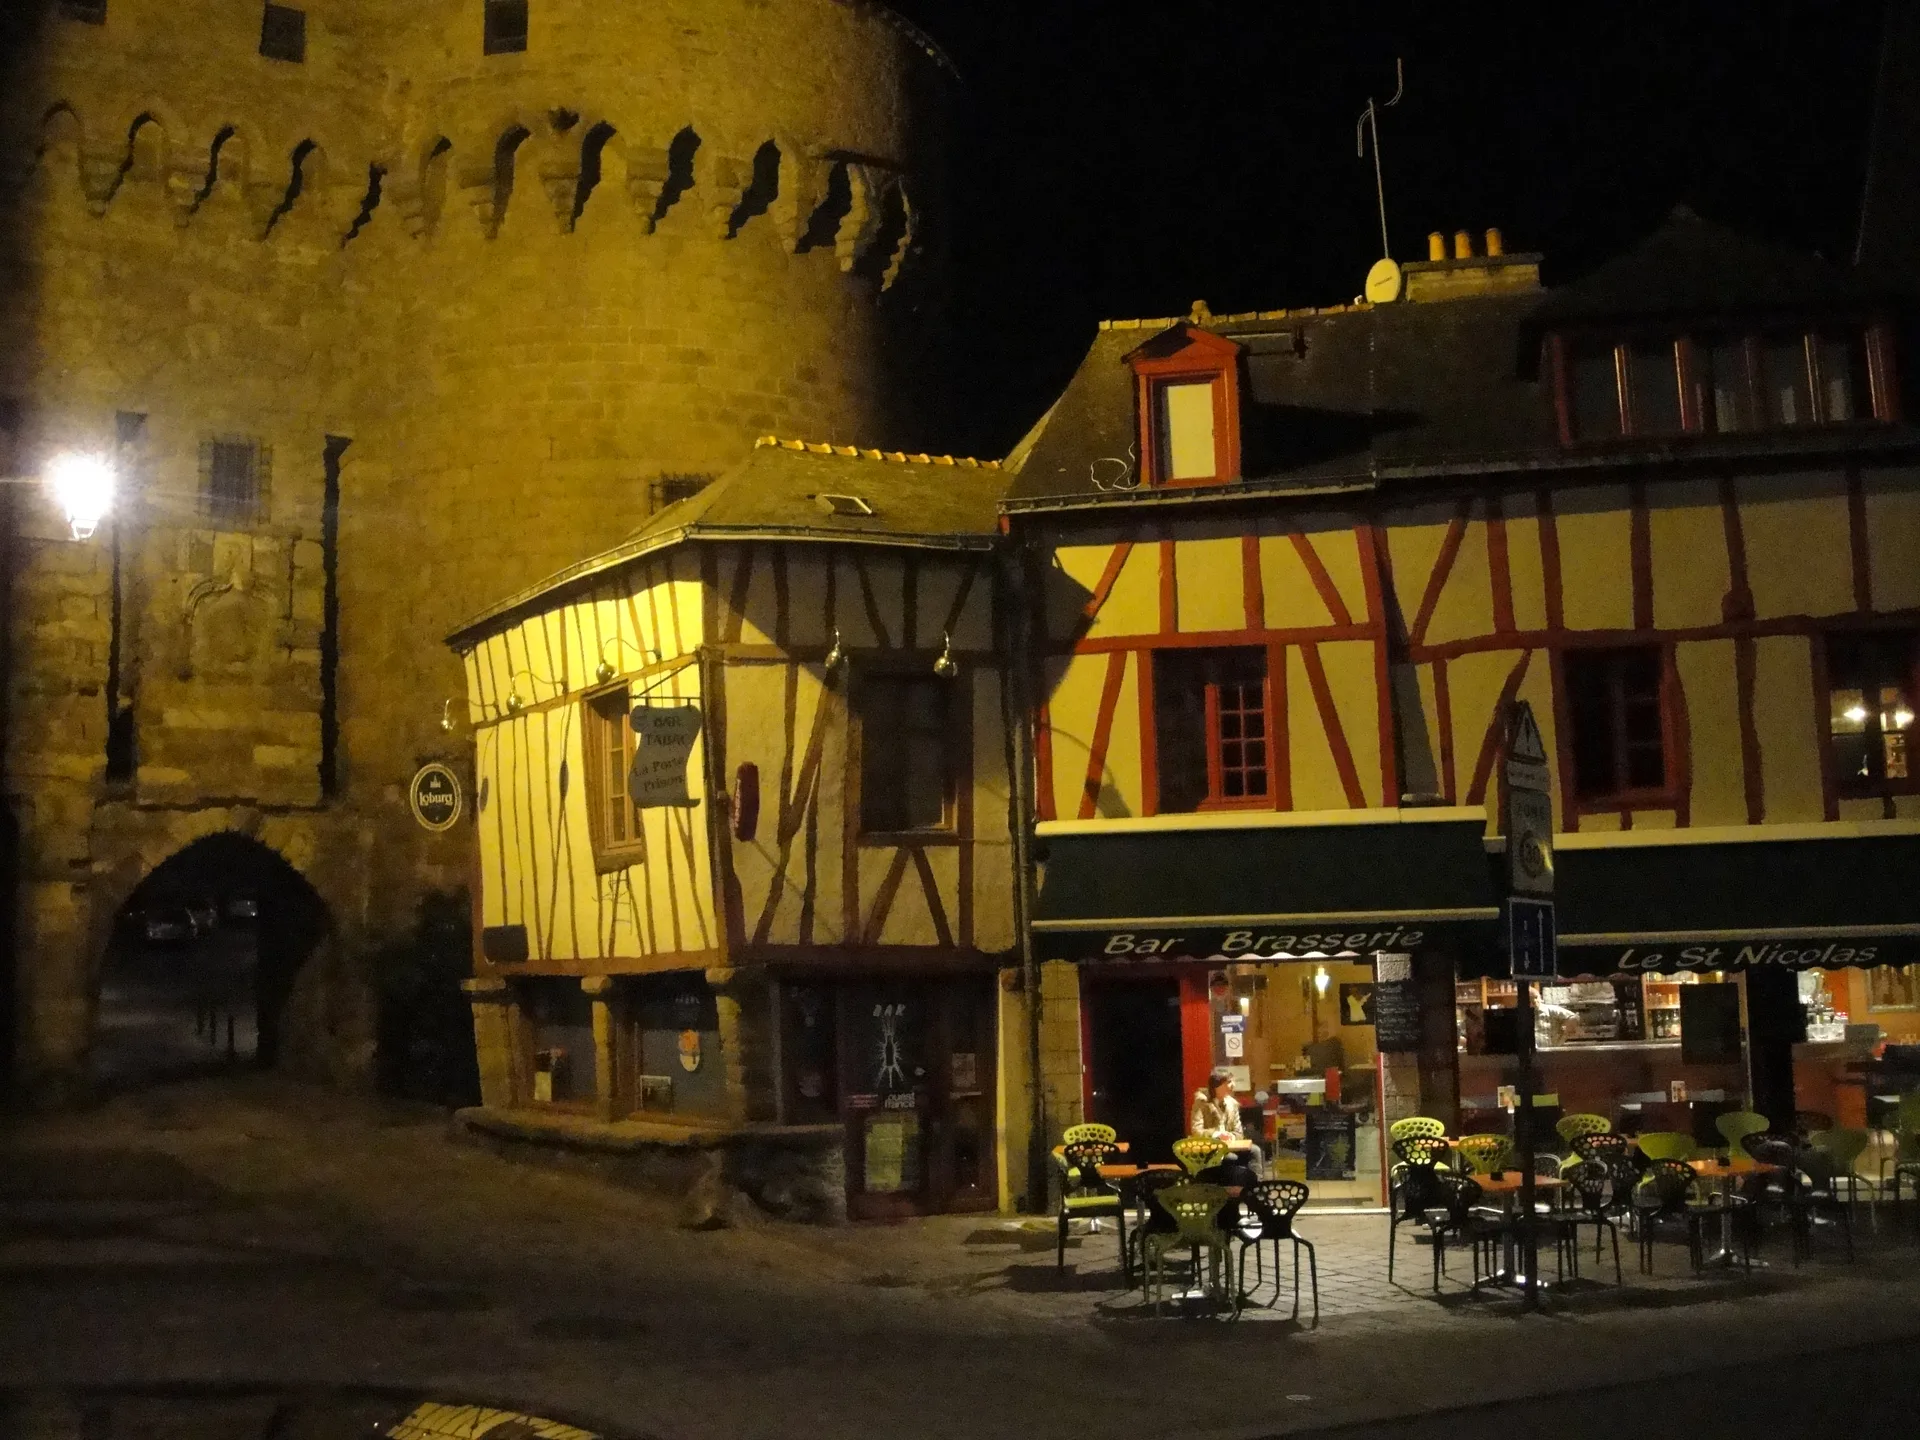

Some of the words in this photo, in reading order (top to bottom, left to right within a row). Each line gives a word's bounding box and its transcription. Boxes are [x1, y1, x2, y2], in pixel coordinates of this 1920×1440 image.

[1104, 933, 1184, 955] Bar
[1220, 926, 1424, 953] Brasserie
[1617, 948, 1663, 969] Le
[1675, 945, 1724, 968] St
[1734, 943, 1878, 966] Nicolas
